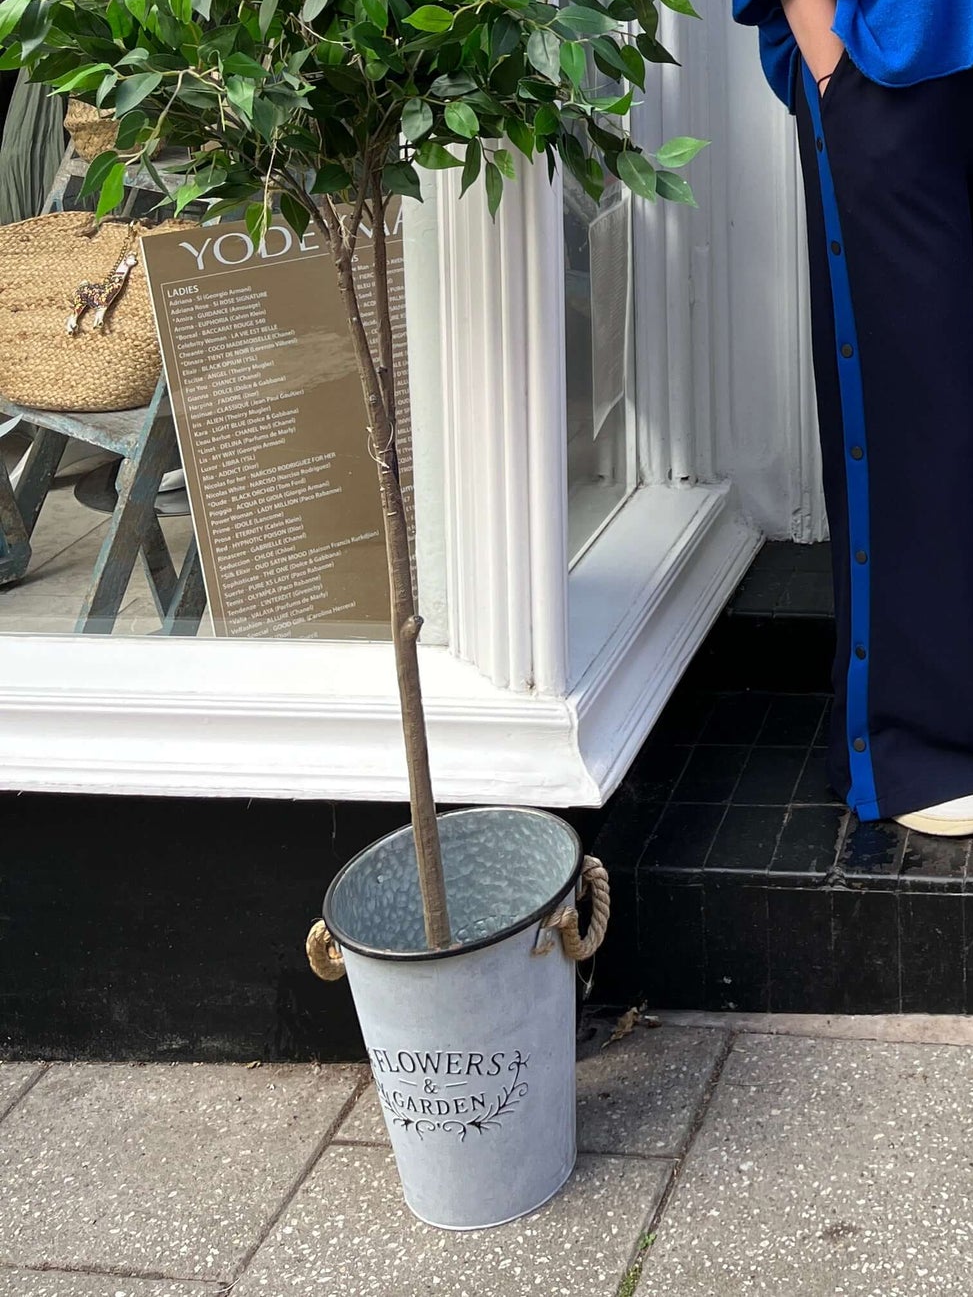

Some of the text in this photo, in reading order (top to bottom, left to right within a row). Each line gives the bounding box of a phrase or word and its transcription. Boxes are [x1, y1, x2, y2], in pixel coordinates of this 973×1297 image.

[166, 284, 200, 298] LADIES
[372, 1049, 505, 1076] FLOWERS
[424, 1078, 440, 1095] &
[393, 1091, 487, 1116] GARDEN
